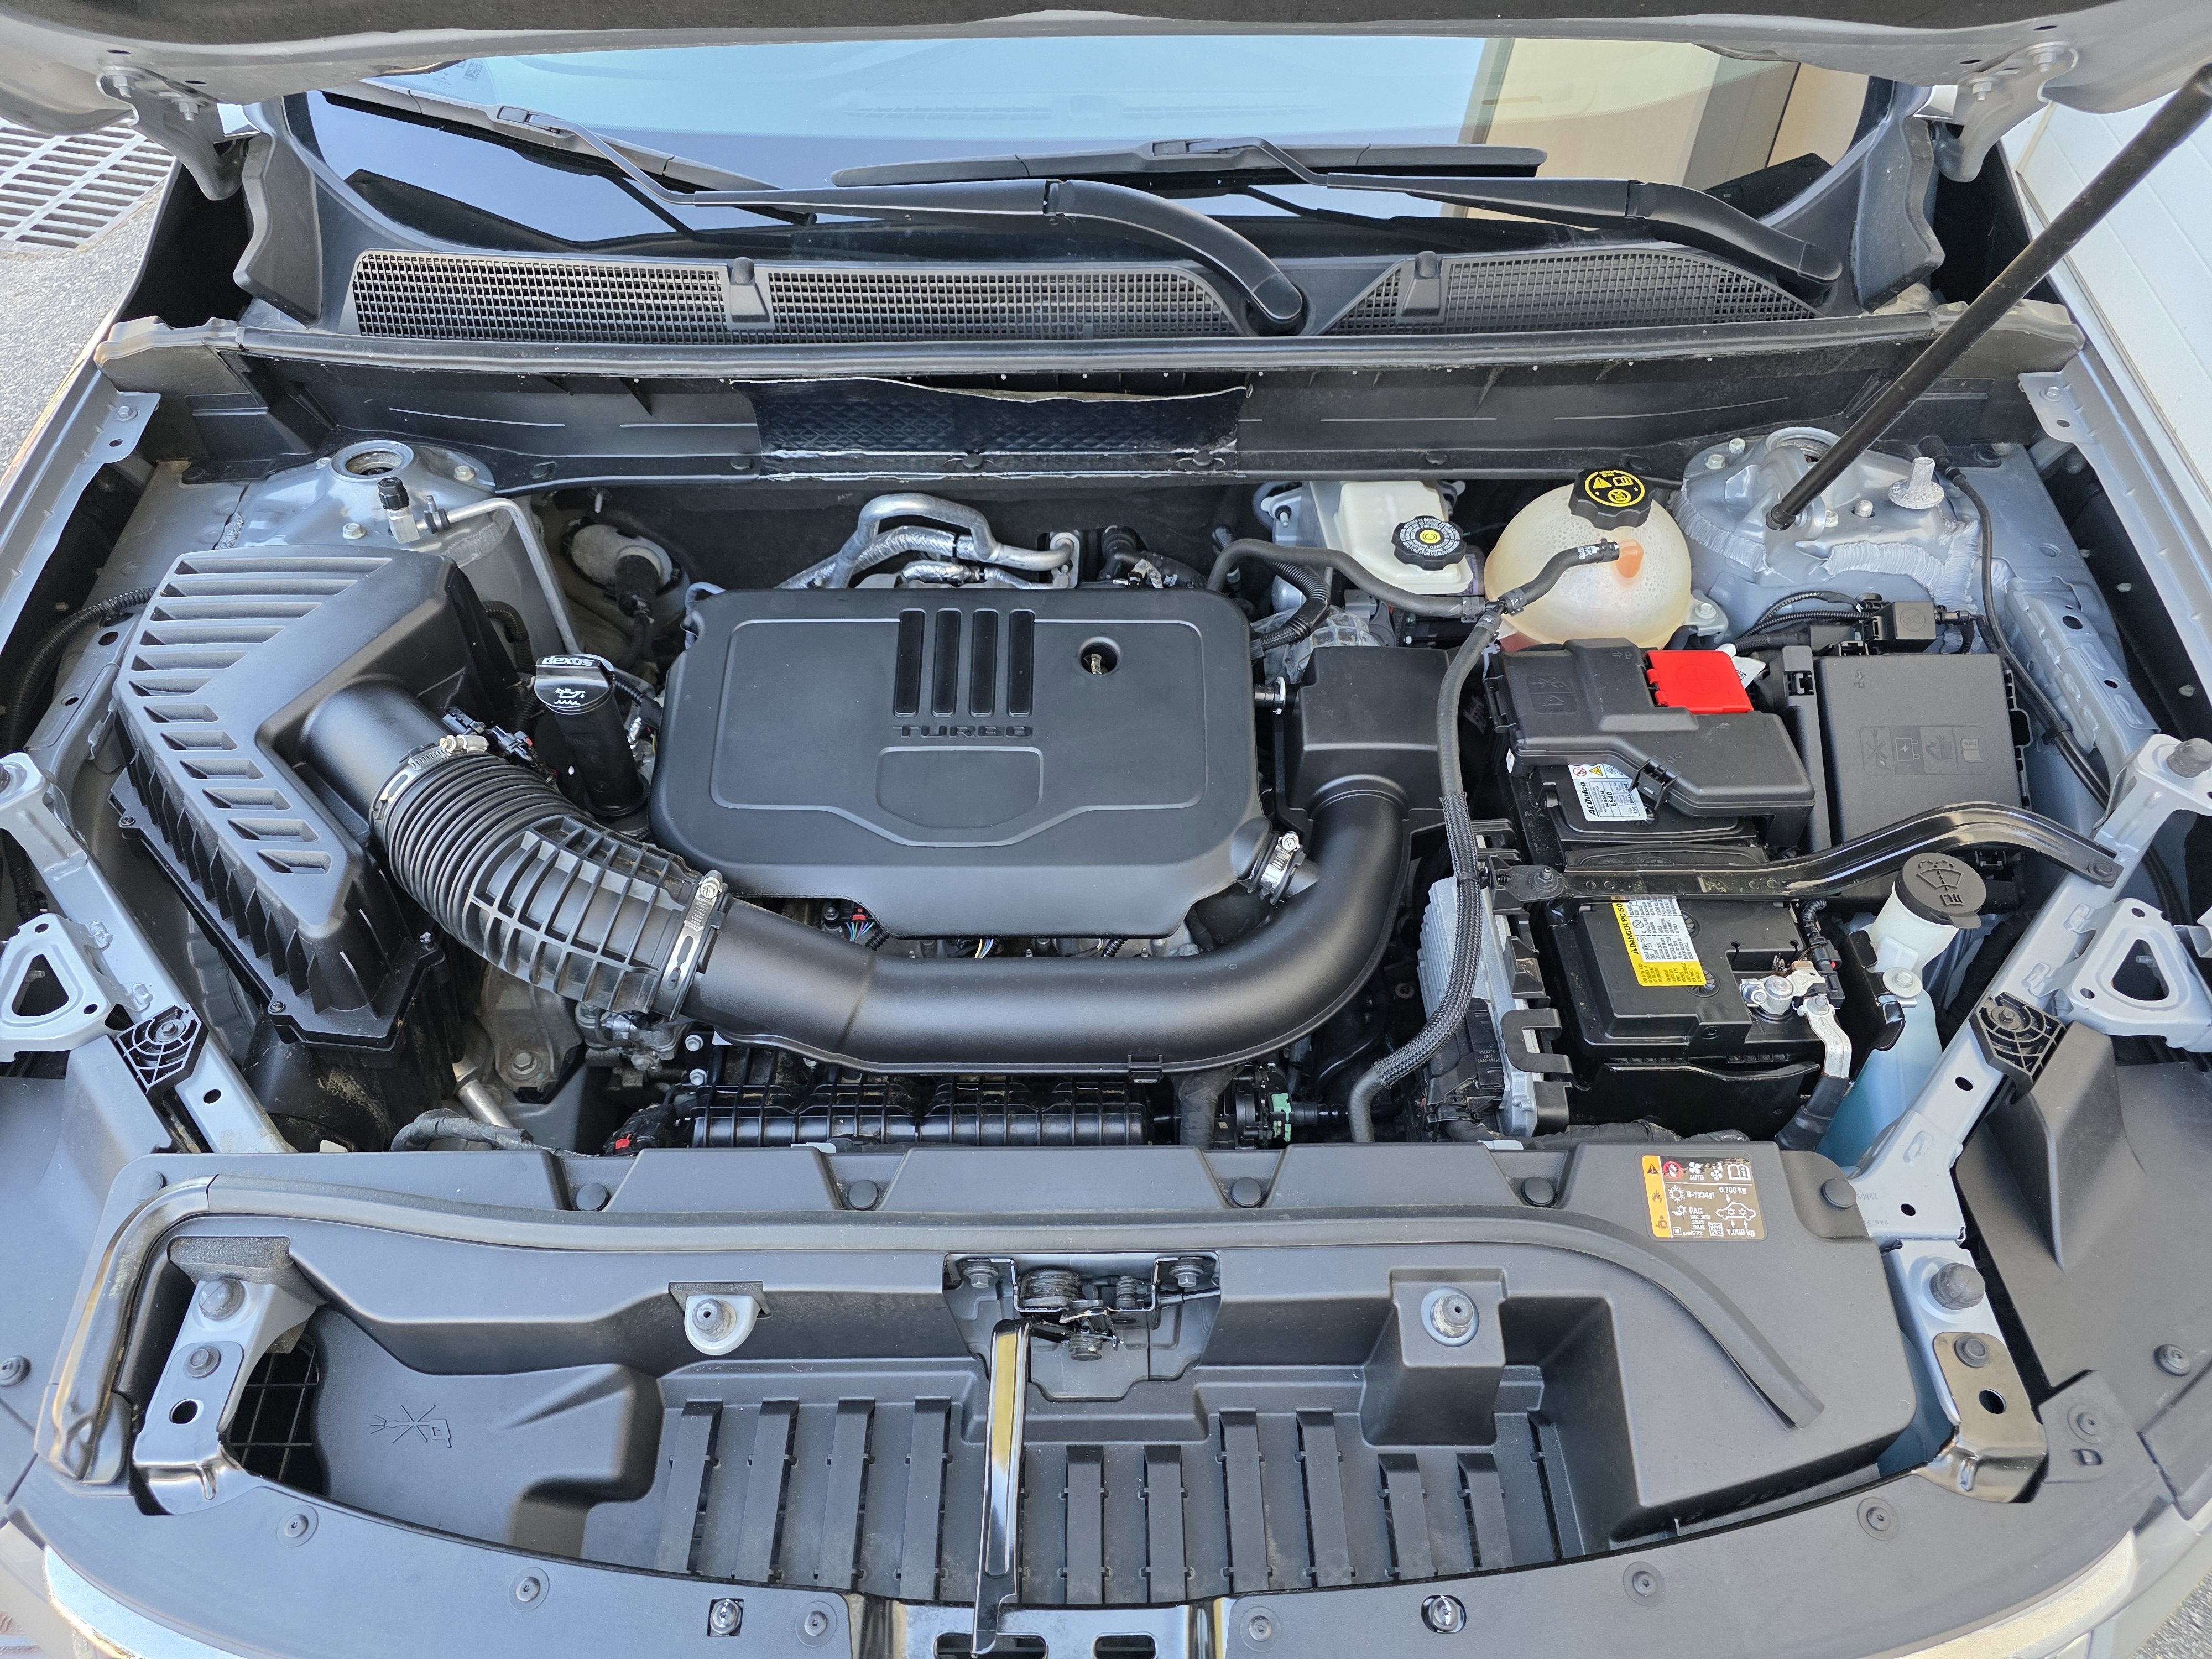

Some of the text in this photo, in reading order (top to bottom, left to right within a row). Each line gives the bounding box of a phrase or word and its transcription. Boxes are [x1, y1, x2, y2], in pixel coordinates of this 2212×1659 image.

[542, 656, 596, 666] dexos
[893, 726, 1034, 738] TURBO
[1580, 782, 1595, 815] ACDelco
[1606, 791, 1616, 806] 8540
[1616, 903, 1636, 947] DANGER/POISO
[1746, 1229, 1755, 1237] kg
